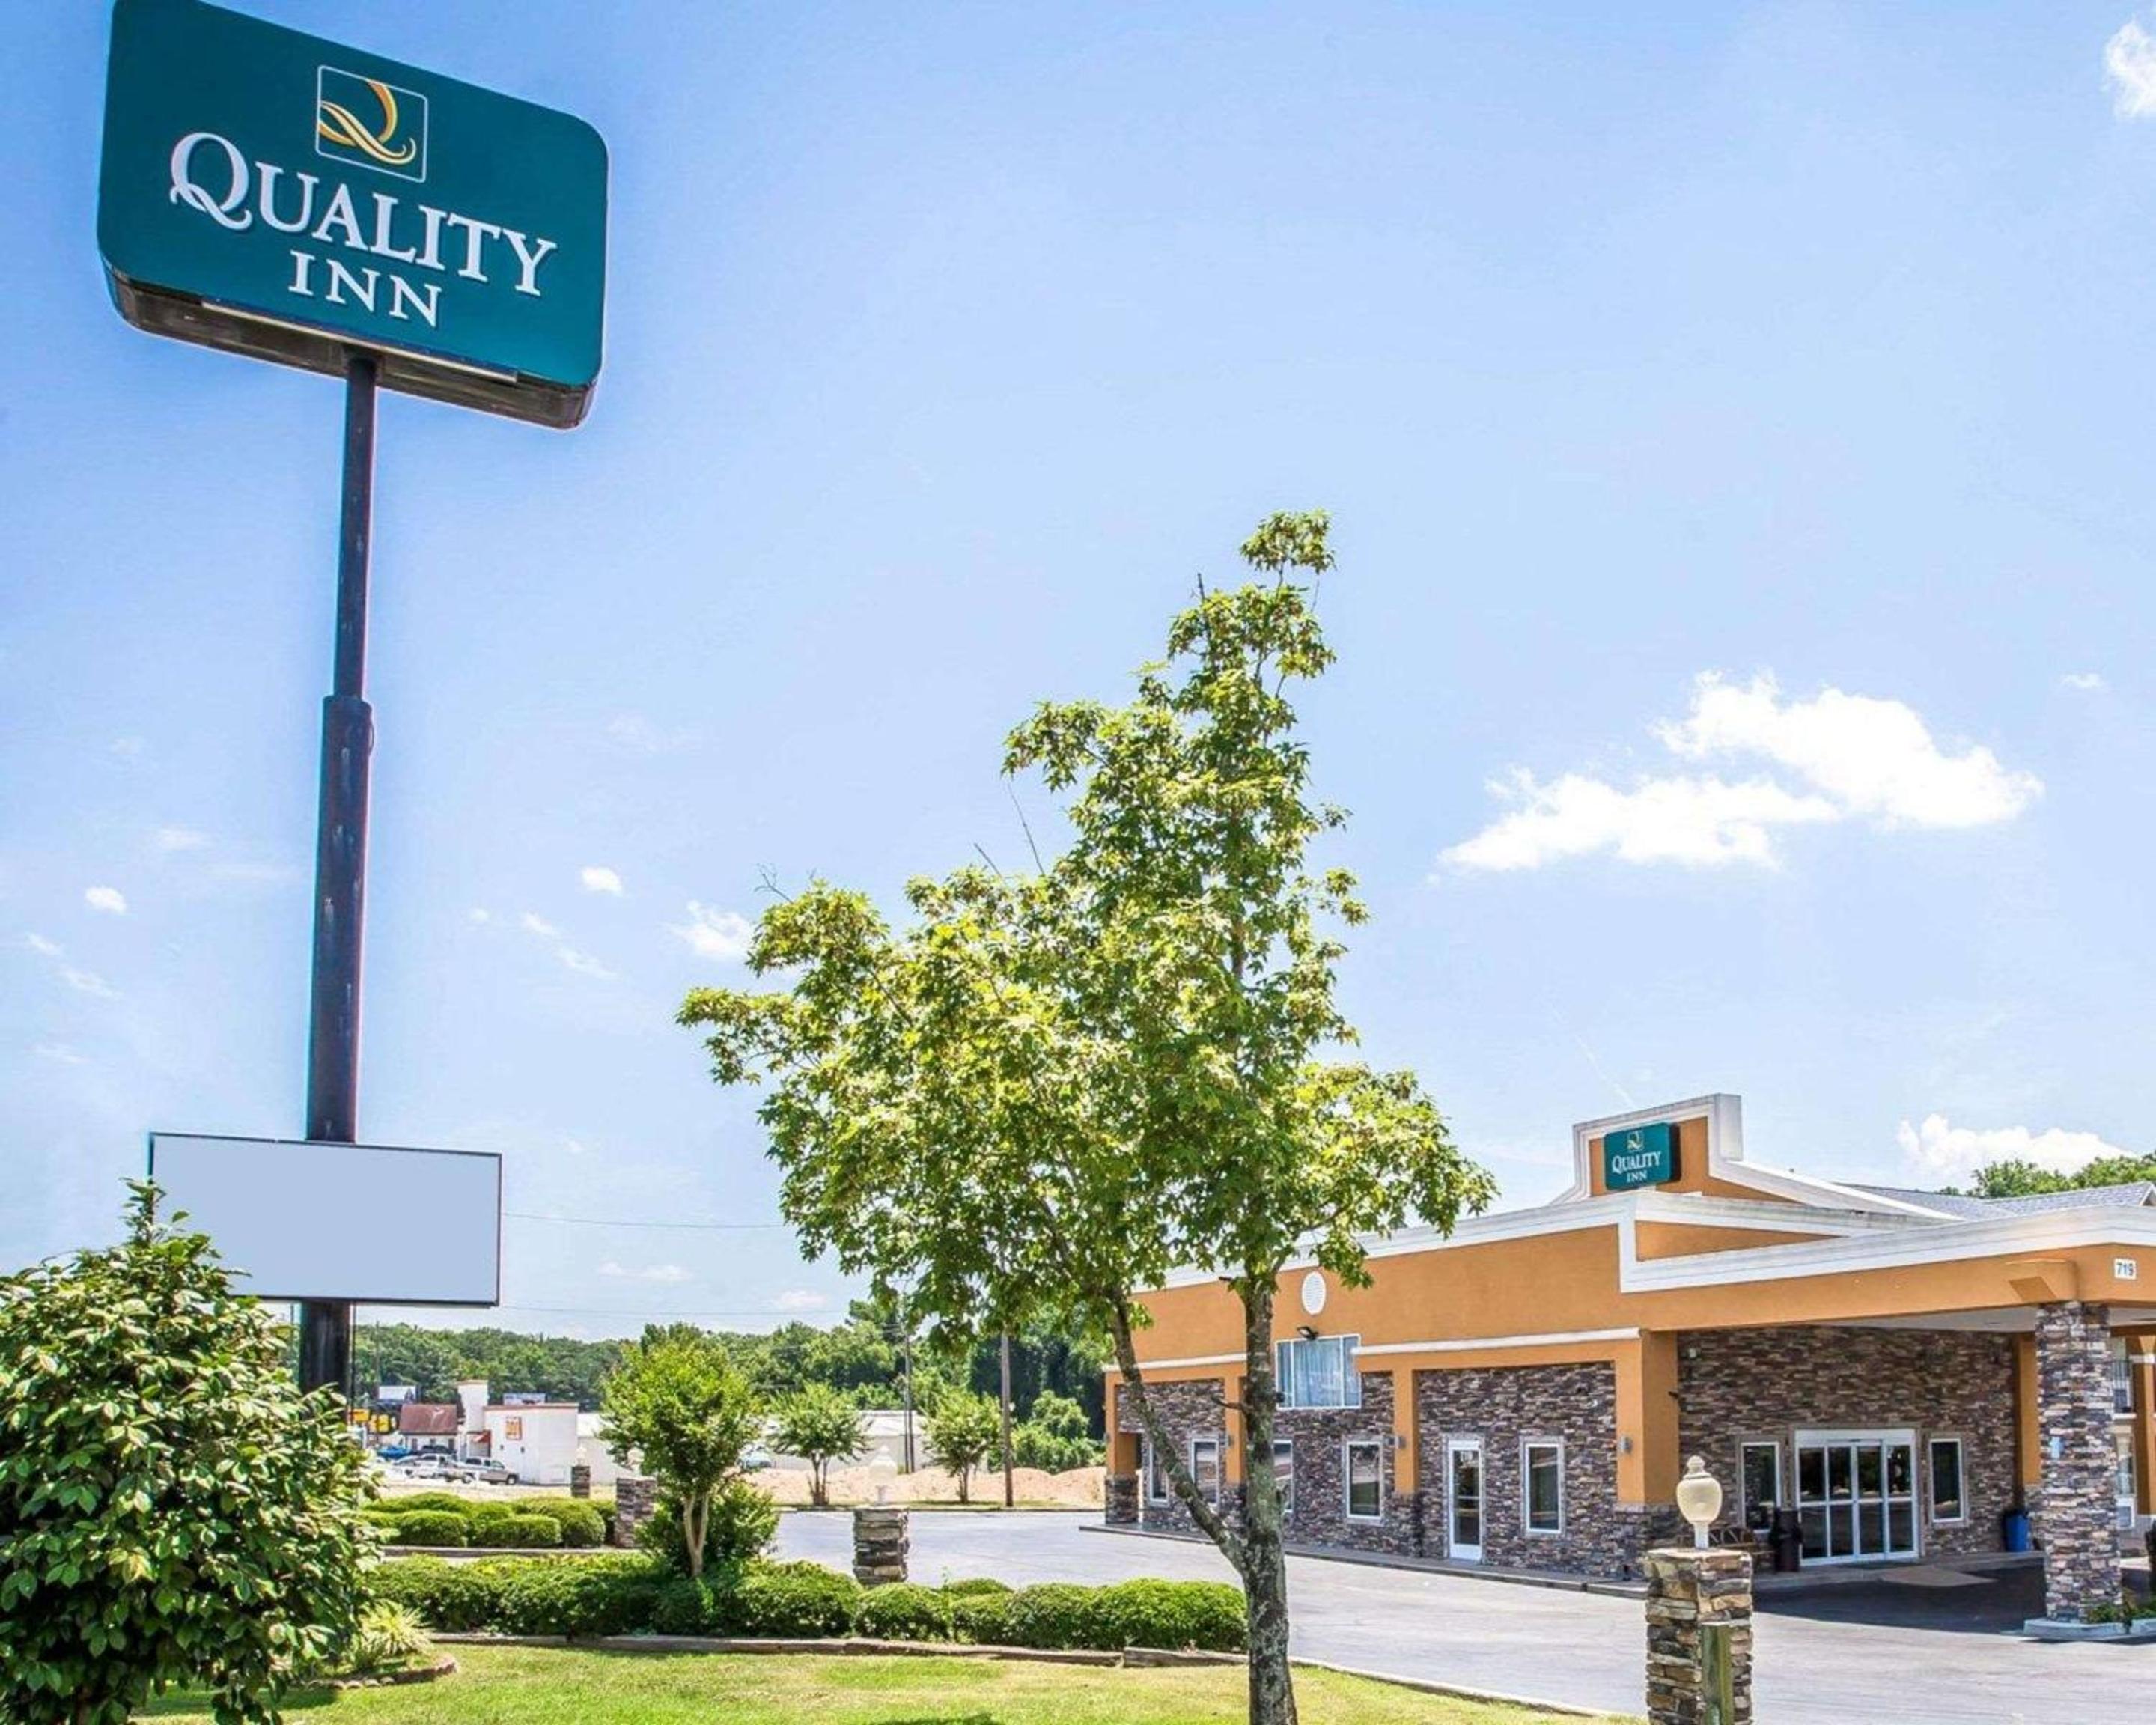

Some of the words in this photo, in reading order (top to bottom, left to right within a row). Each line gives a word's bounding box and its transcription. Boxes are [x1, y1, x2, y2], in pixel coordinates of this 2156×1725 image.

[170, 132, 556, 296] QUALITY
[288, 251, 442, 327] INN
[1612, 1151, 1661, 1174] QUALITY
[1627, 1170, 1647, 1182] INN
